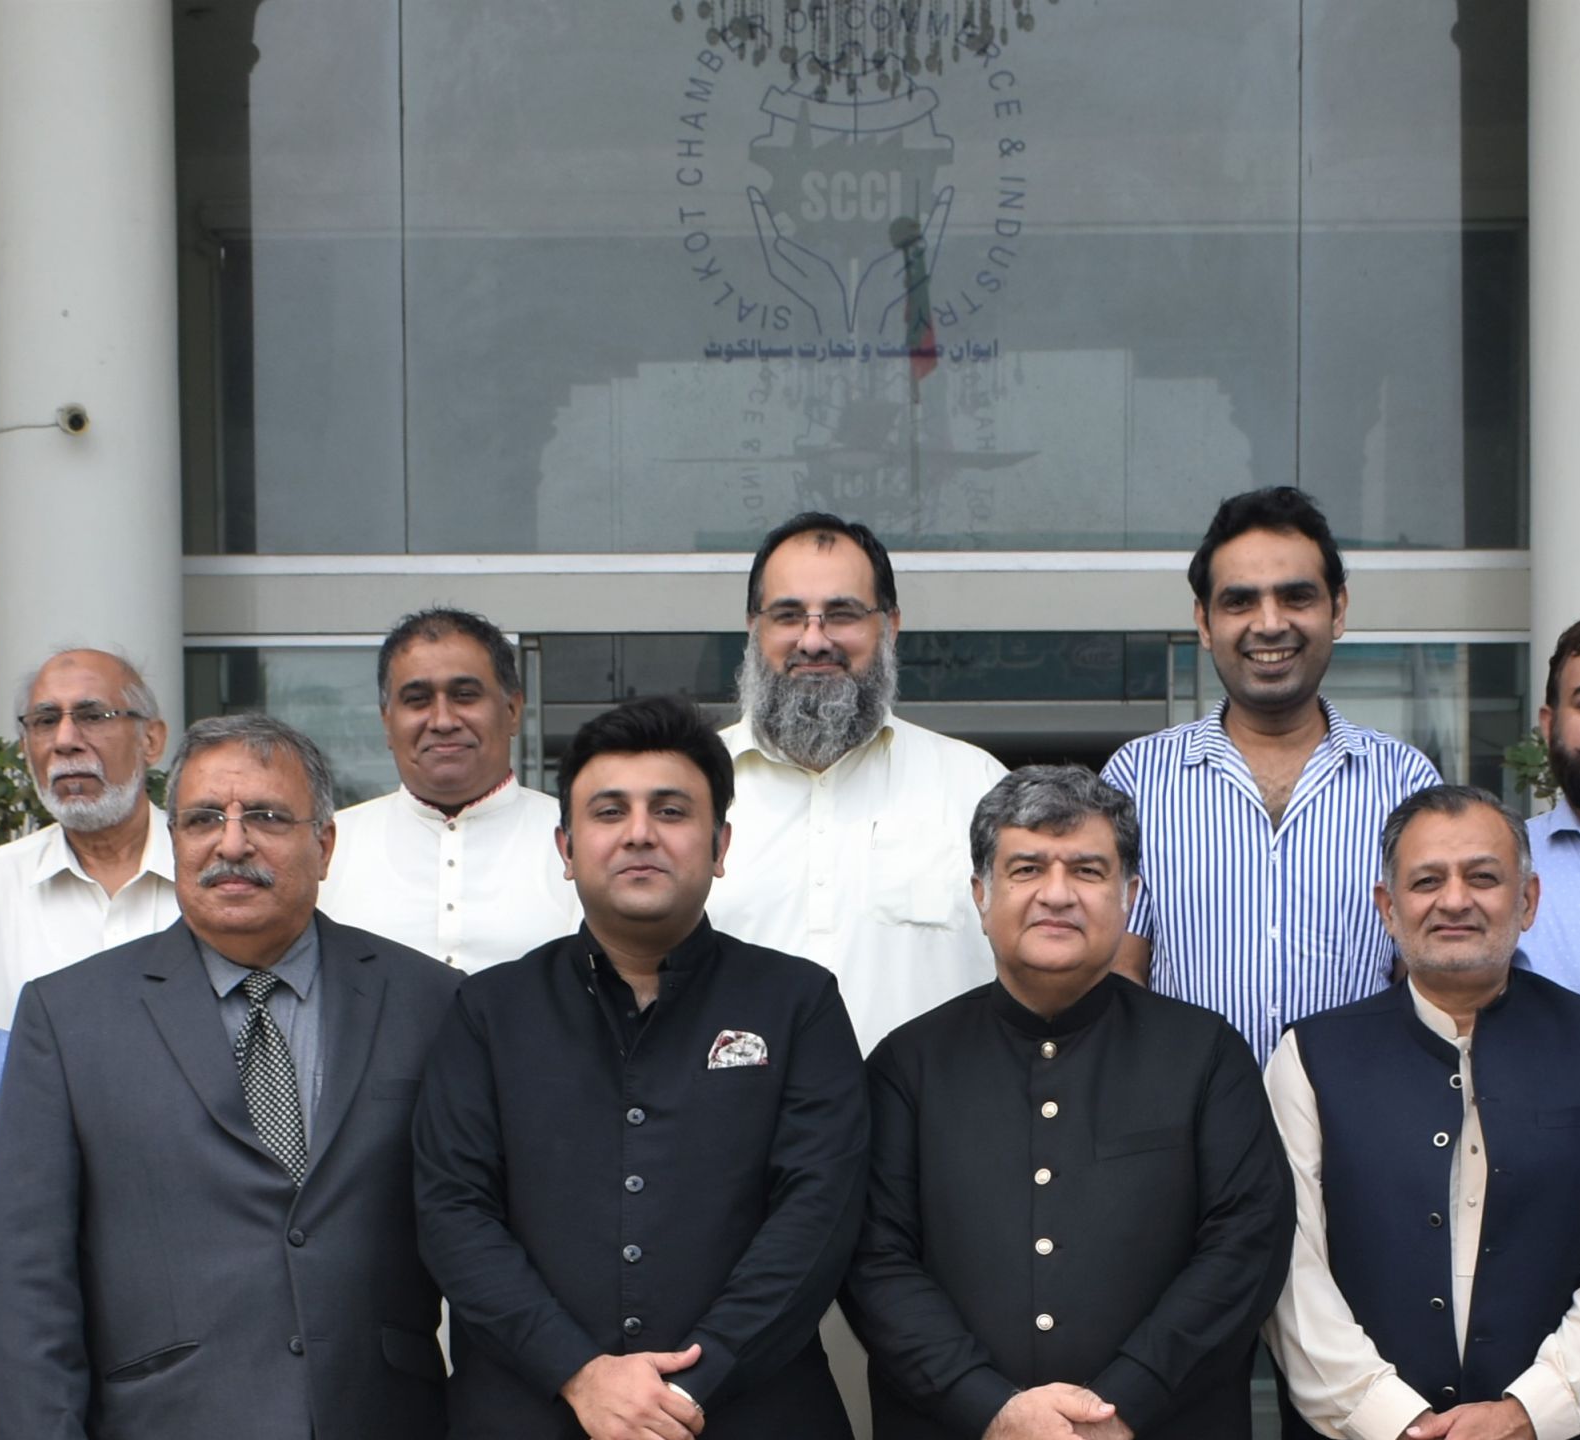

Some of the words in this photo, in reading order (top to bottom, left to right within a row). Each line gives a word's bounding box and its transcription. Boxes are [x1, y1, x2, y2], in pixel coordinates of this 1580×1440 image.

[800, 169, 901, 222] SCCI
[678, 206, 792, 331] SIALKOT
[998, 138, 1026, 158] &
[798, 338, 856, 363] تجارت
[950, 337, 999, 363] ایوان
